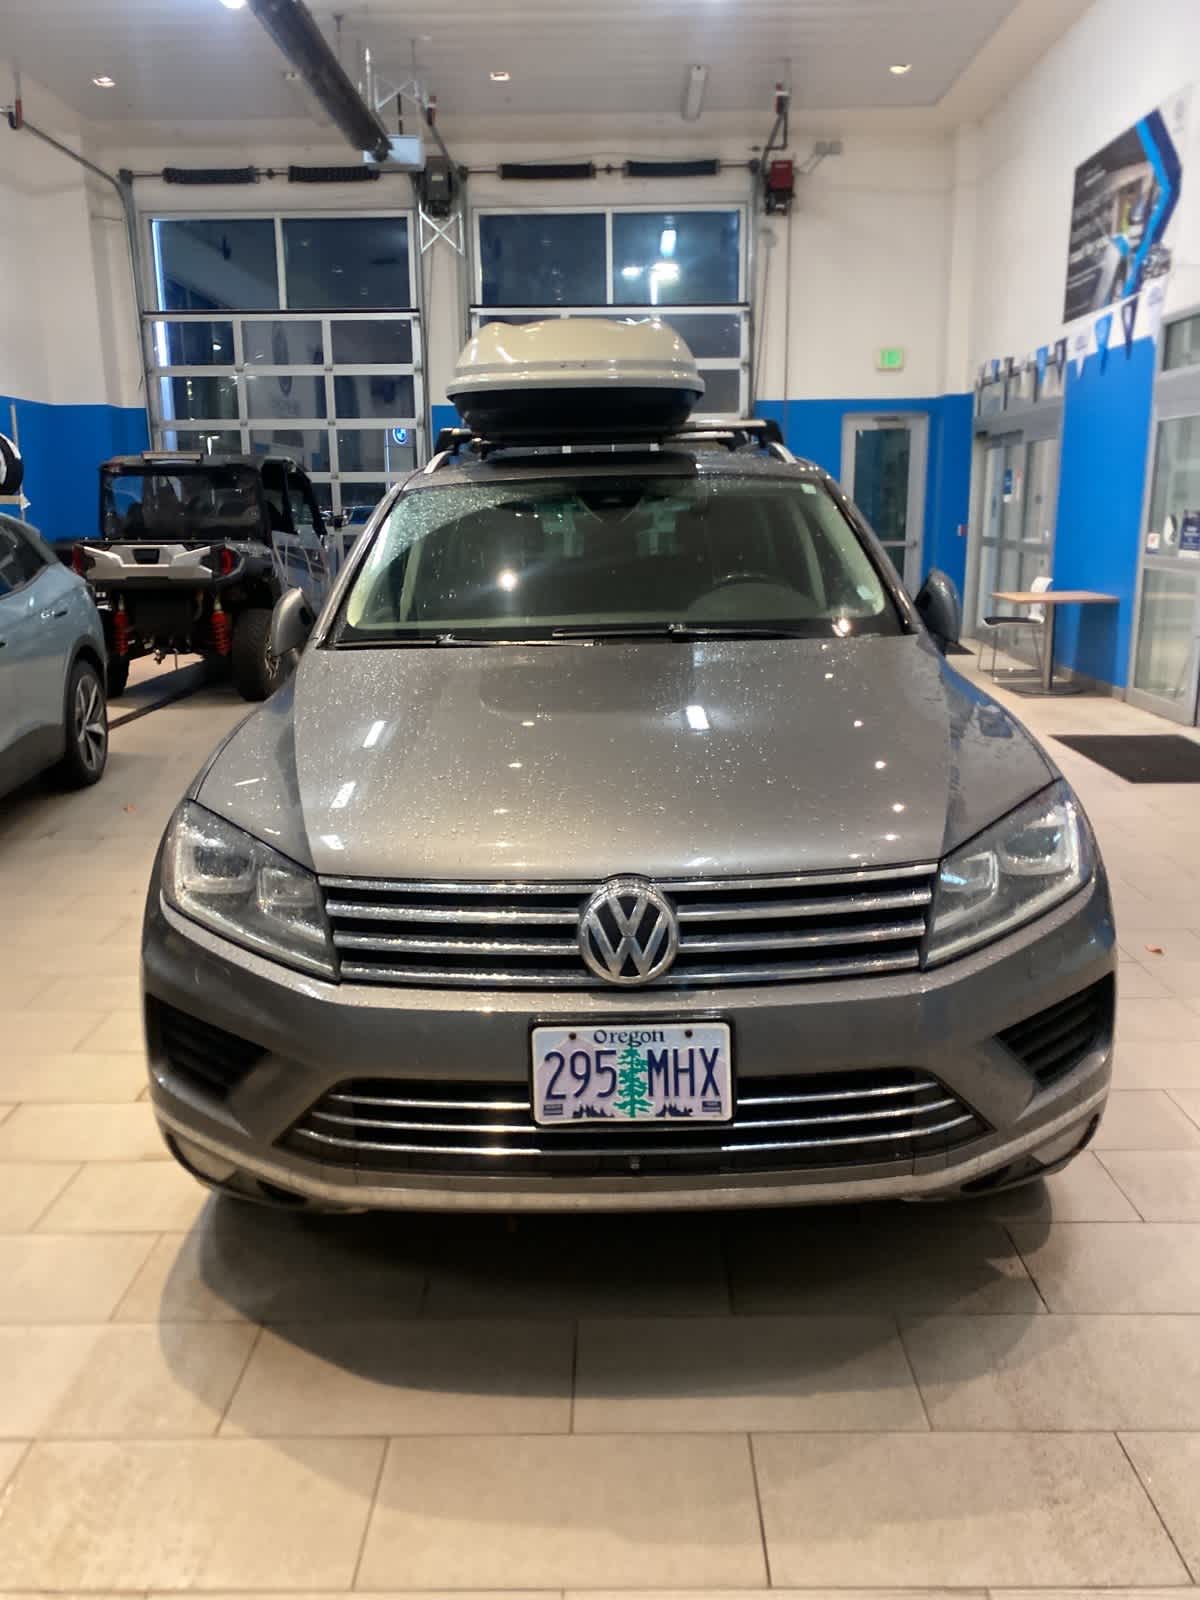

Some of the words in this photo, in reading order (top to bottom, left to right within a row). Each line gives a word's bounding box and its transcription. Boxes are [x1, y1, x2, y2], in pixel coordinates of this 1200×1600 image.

[585, 887, 671, 979] VW
[593, 1029, 665, 1047] Oregon
[544, 1050, 618, 1100] 295
[647, 1047, 721, 1098] MHX
